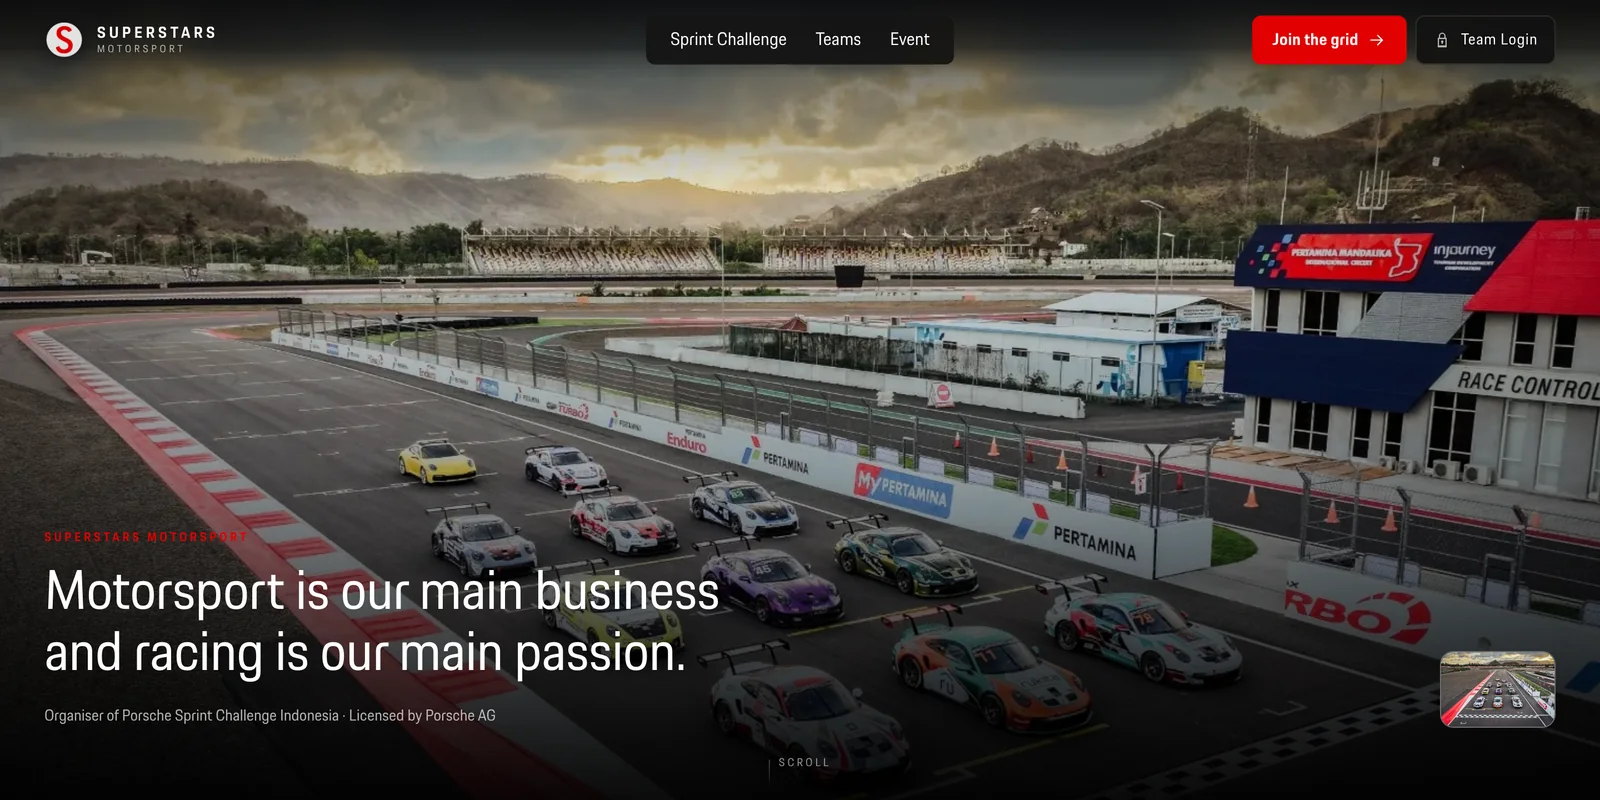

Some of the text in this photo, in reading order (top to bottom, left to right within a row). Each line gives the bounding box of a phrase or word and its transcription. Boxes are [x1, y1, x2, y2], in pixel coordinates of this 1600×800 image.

[1291, 248, 1392, 257] PERTAMINA MANDALIKA
[1458, 371, 1600, 401] RACE CONTROL
[558, 404, 584, 420] TURBO
[667, 431, 707, 454] Enduro
[763, 451, 809, 475] PERTAMINA
[1053, 525, 1137, 561] PERTAMINA
[1136, 612, 1155, 626] 78
